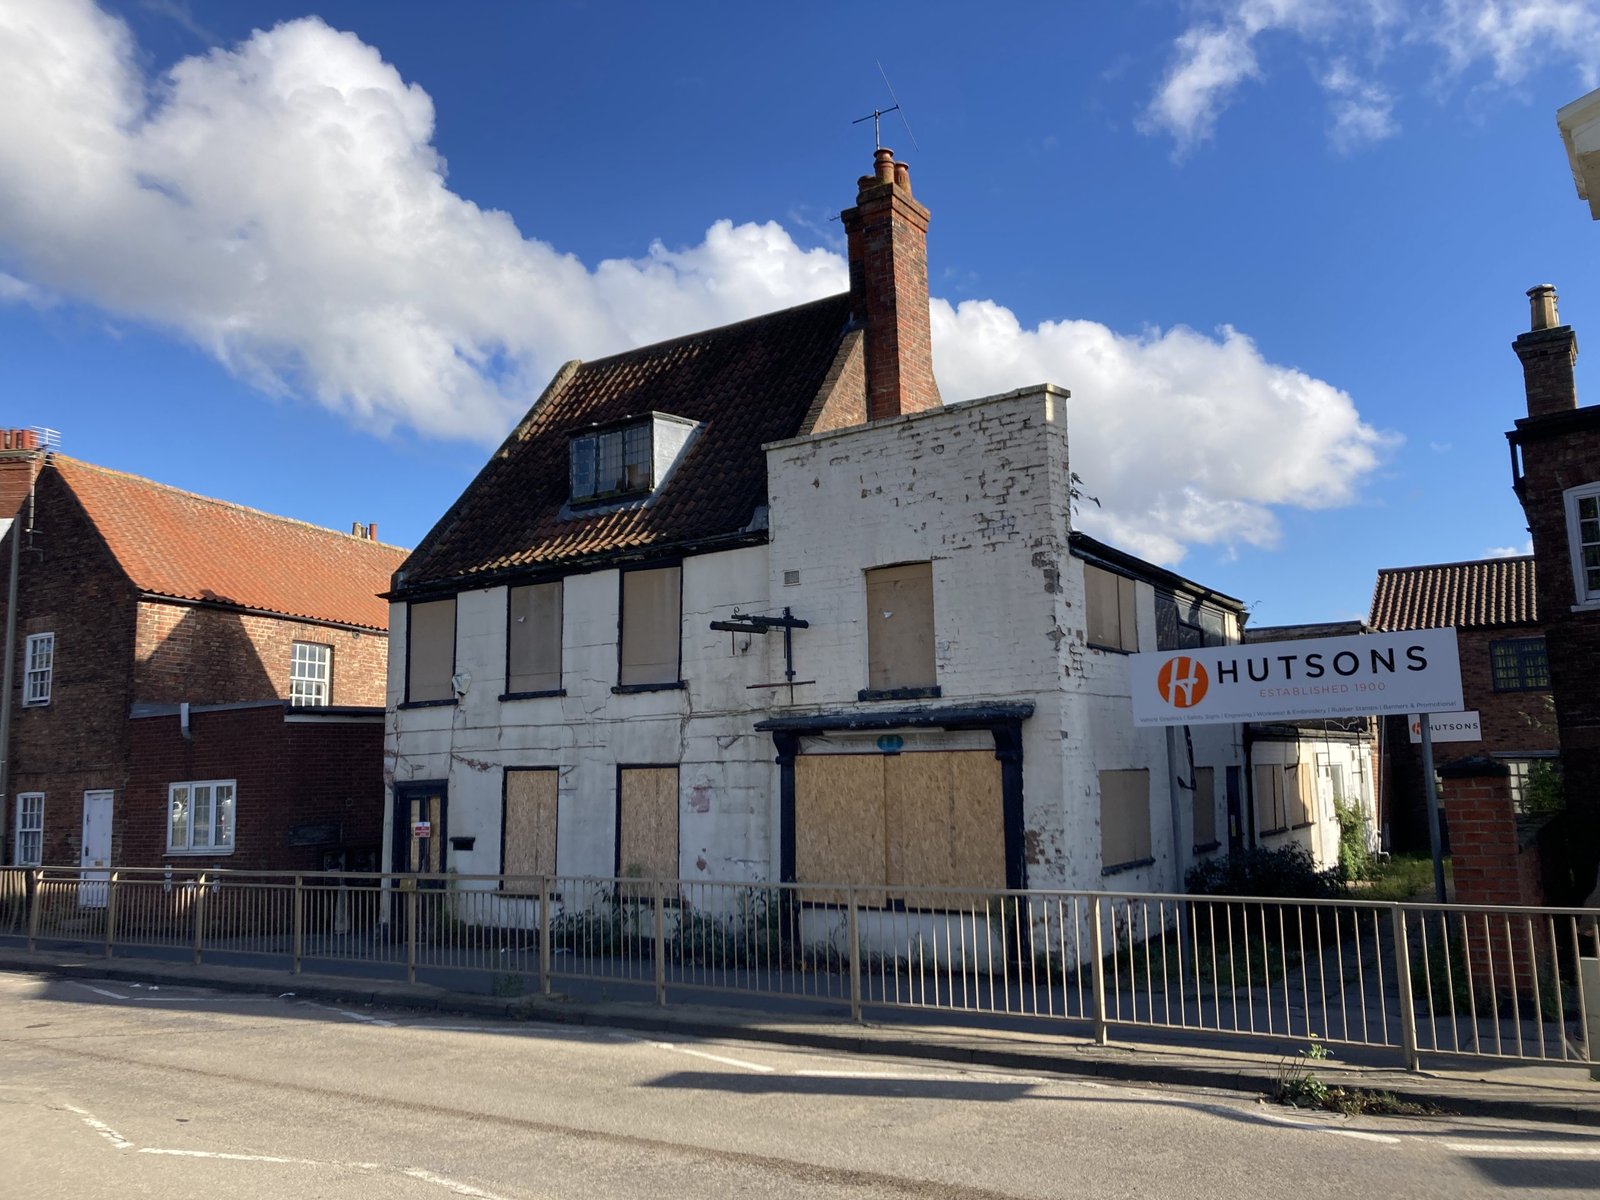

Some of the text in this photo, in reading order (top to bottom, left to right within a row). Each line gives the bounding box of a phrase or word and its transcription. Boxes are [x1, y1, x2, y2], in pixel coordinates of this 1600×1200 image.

[1217, 645, 1428, 684] HUTSONS
[1260, 681, 1386, 698] ESTABLISHED 1900
[1224, 711, 1253, 720] Engraving
[1292, 707, 1327, 716] Embroidery
[1331, 705, 1353, 713] Rubber
[1416, 700, 1457, 708] Promotional
